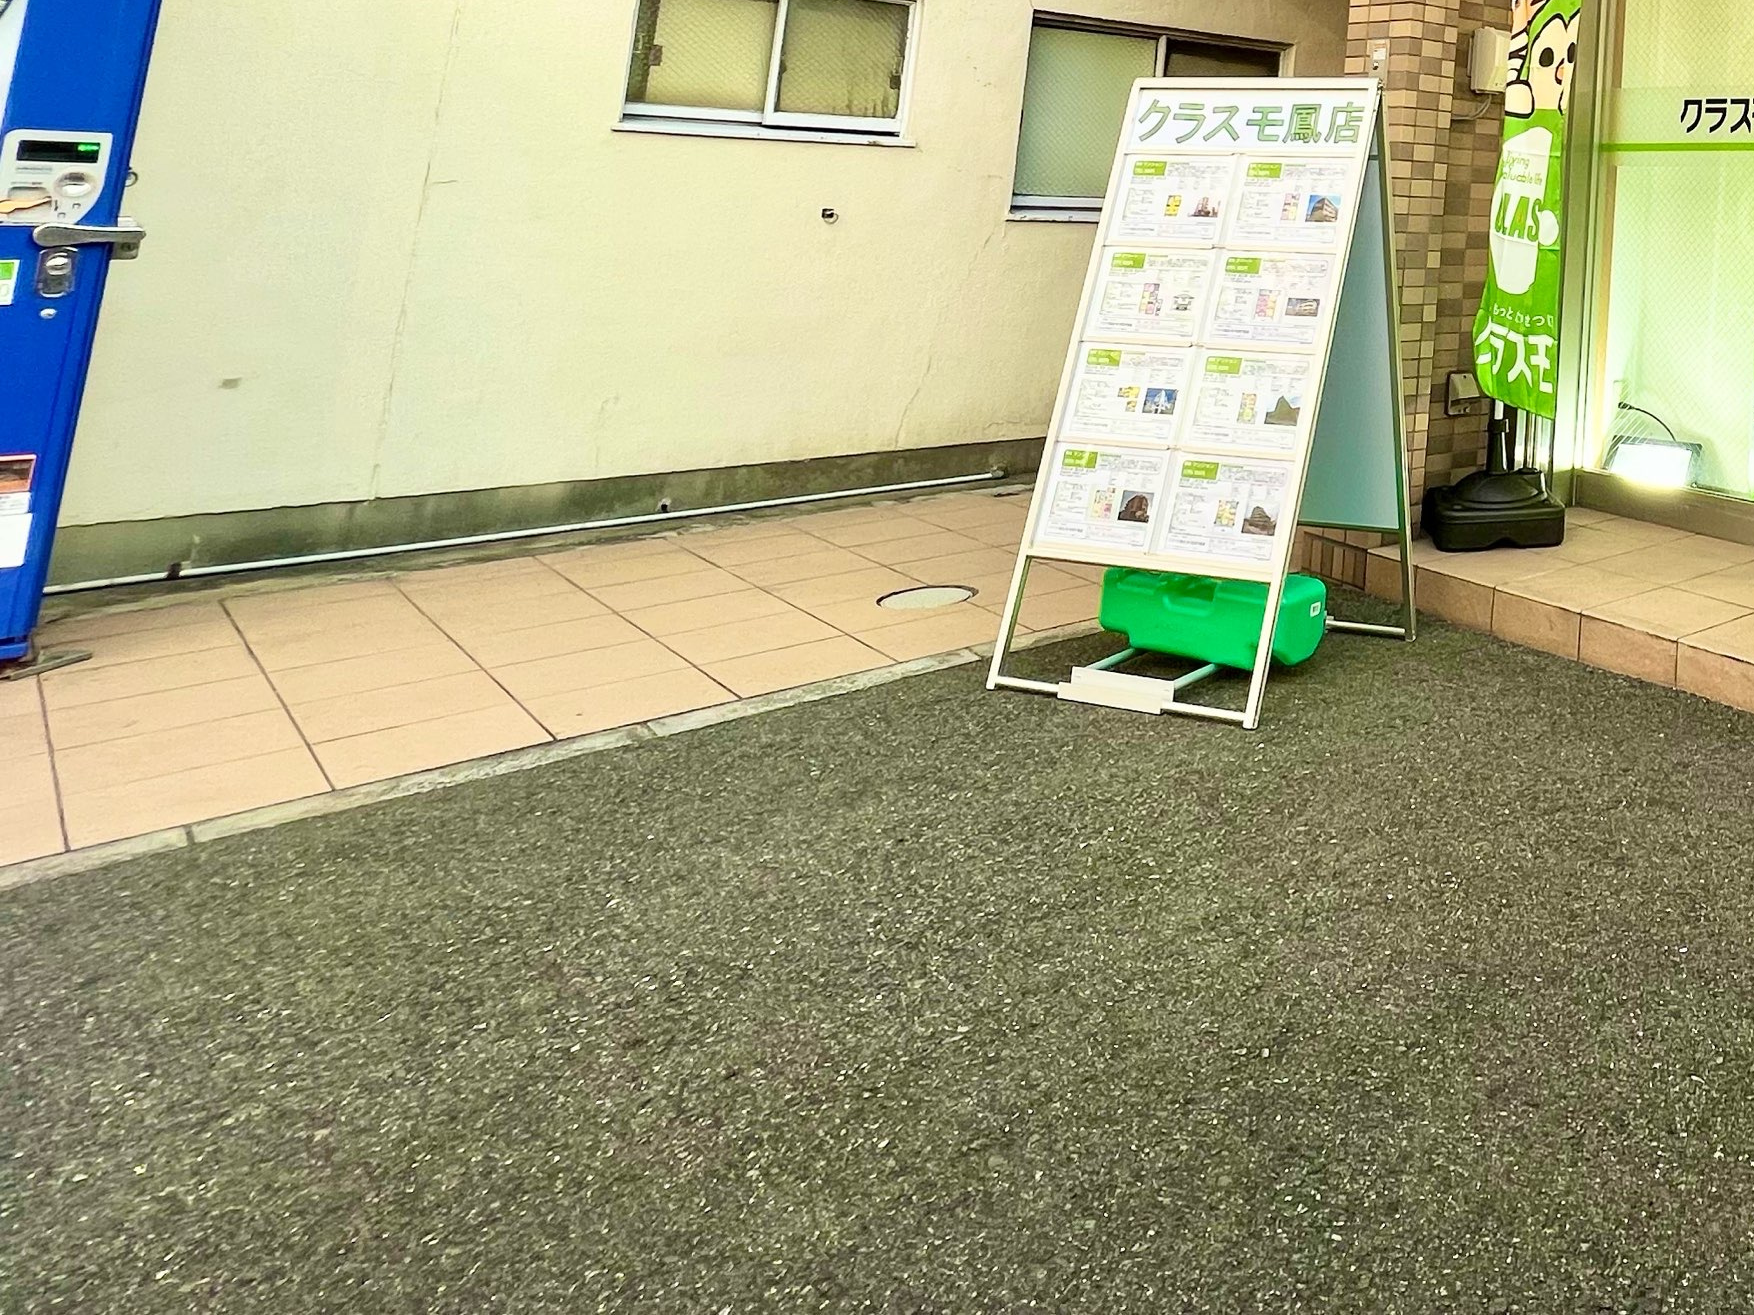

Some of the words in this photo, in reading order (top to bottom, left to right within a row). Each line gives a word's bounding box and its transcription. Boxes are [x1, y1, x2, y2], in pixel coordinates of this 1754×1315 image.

[1138, 98, 1366, 144] クラスモ鳳店
